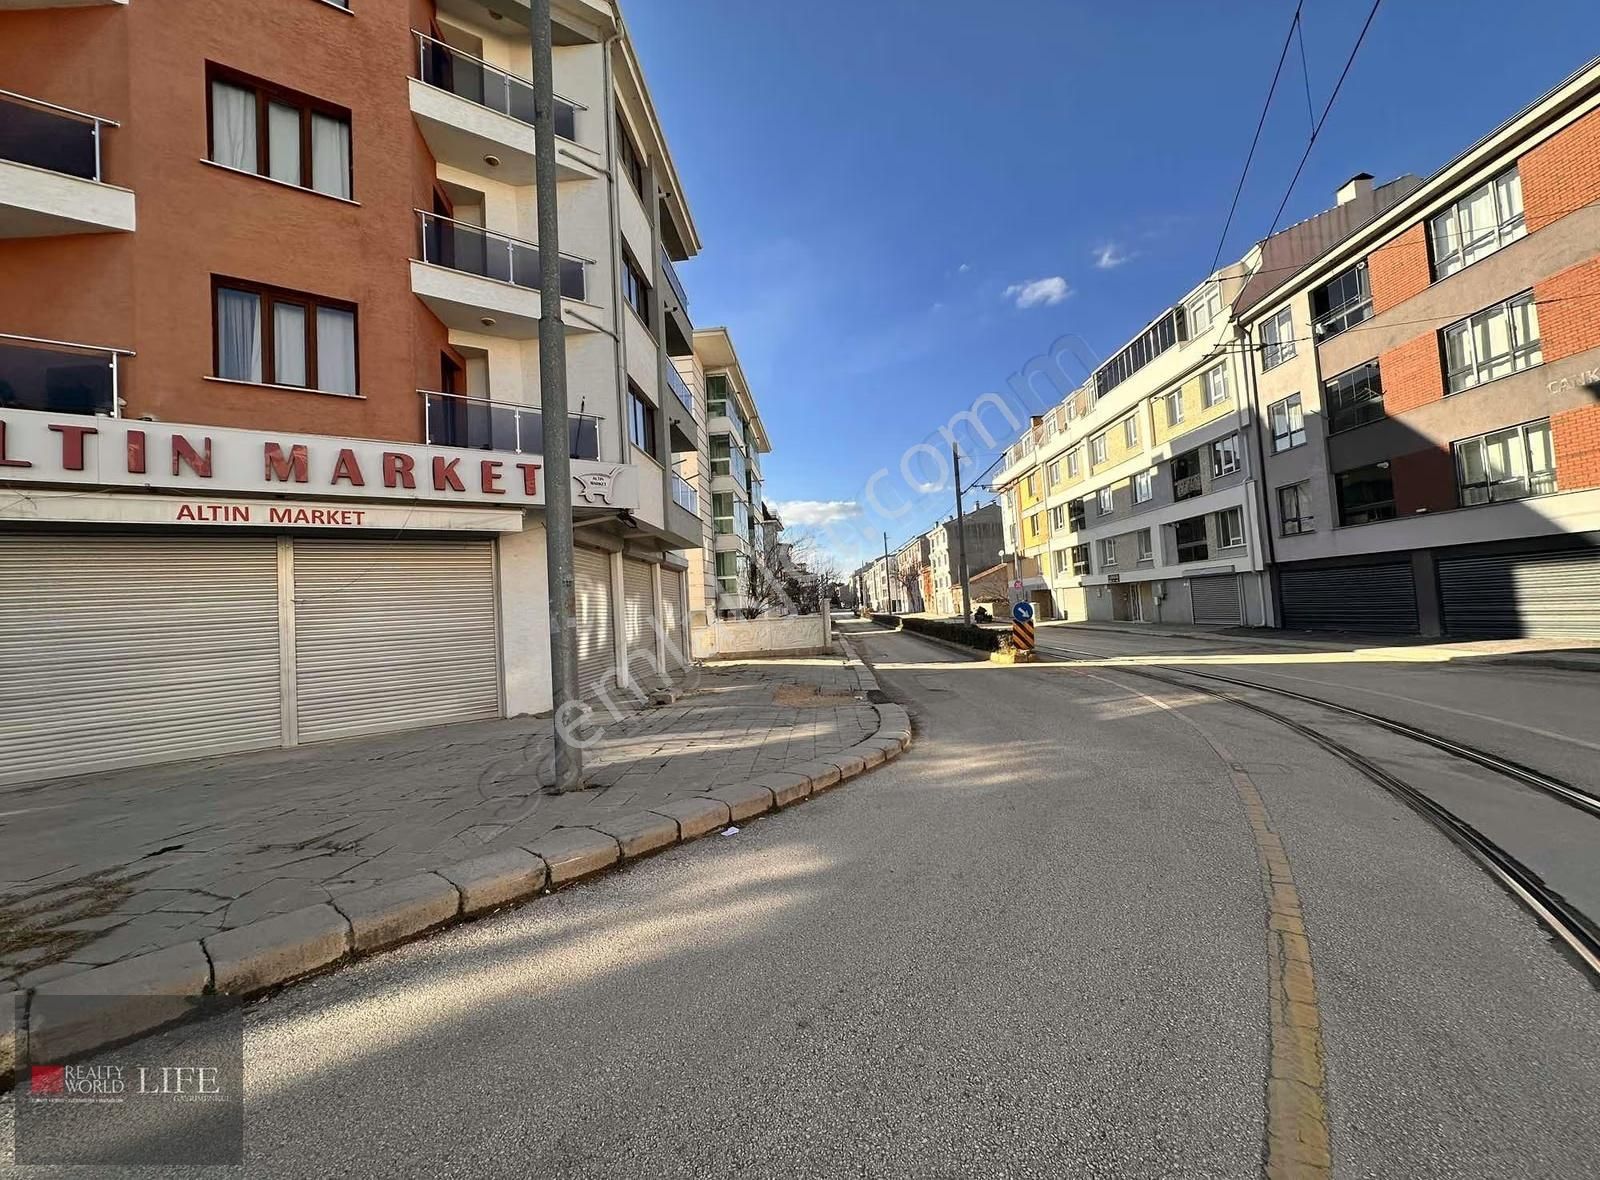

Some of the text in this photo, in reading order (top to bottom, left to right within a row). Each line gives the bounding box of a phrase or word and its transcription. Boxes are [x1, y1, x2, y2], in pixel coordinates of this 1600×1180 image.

[264, 441, 542, 496] MARKET
[176, 504, 366, 526] ALTIN MARKET
